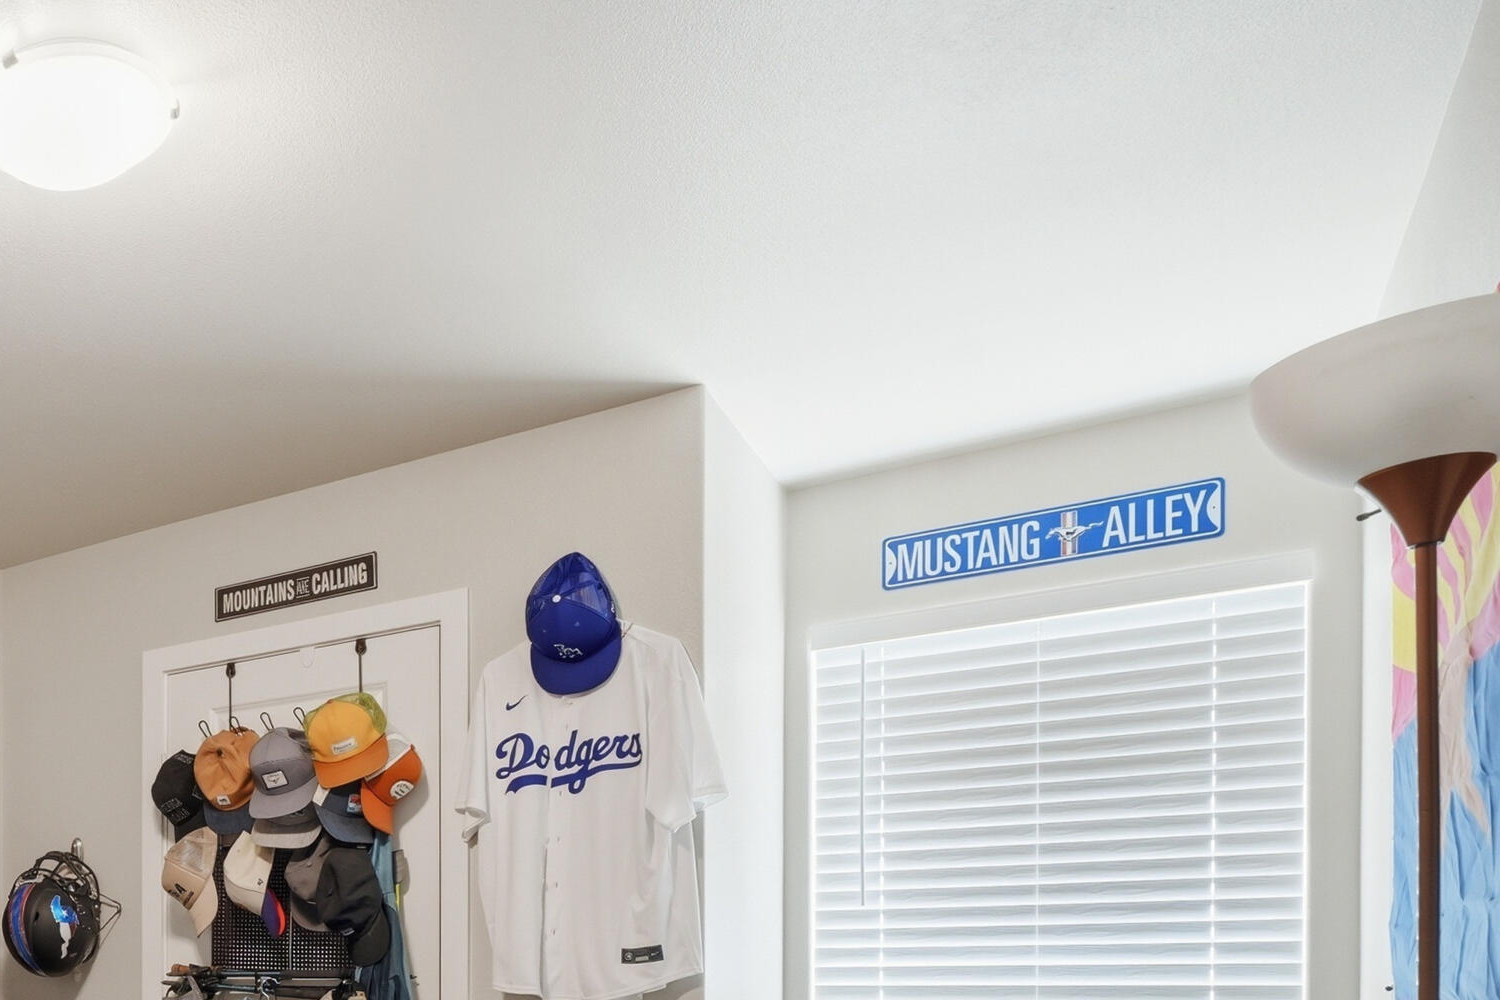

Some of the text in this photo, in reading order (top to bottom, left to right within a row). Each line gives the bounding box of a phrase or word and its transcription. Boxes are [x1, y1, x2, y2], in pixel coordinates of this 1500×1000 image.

[897, 489, 1207, 581] MUSTANG ALLEY
[223, 579, 295, 614] MOUNTAINS
[311, 562, 368, 595] CALLING
[496, 729, 642, 795] Dodgers
